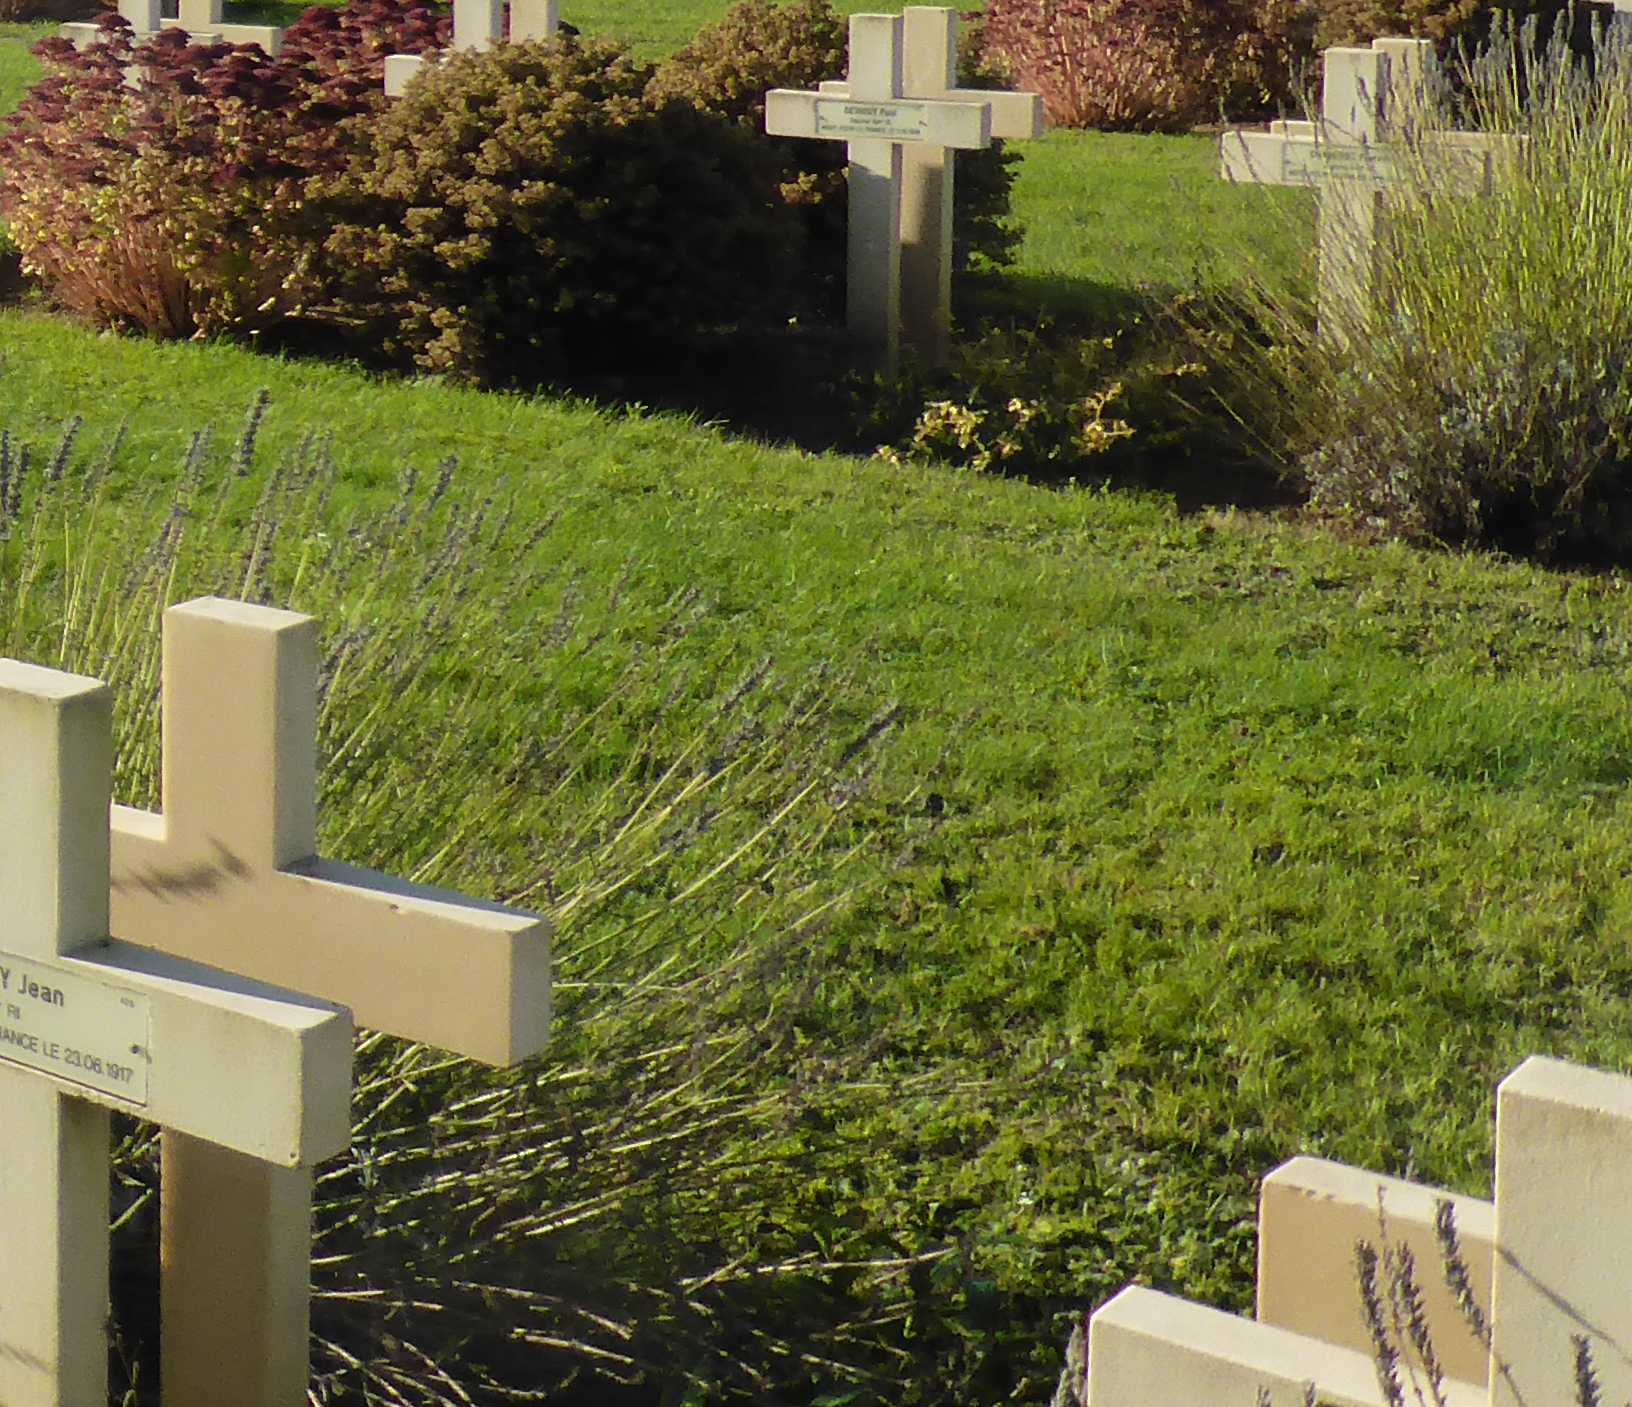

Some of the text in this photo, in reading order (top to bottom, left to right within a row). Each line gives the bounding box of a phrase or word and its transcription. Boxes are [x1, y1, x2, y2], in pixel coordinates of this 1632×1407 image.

[17, 973, 65, 1007] Jean
[7, 1003, 20, 1020] RI
[42, 1039, 60, 1060] LE
